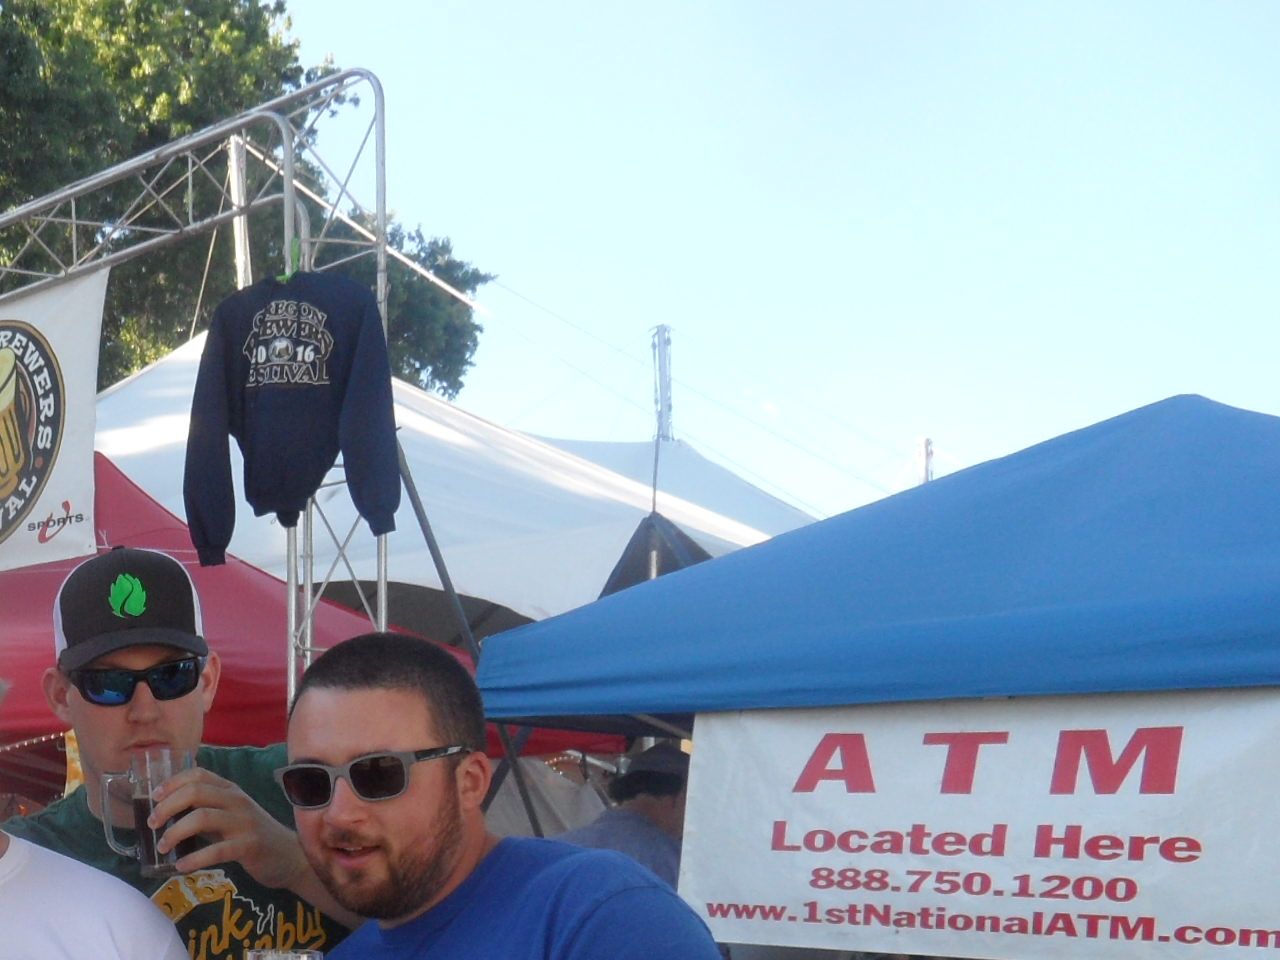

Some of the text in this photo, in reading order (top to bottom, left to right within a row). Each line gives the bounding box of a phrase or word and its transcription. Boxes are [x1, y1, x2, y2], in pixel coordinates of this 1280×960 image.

[245, 355, 331, 387] ESTIVAL
[295, 344, 316, 364] 16
[771, 820, 1202, 863] Located Here
[808, 867, 1138, 903] 888.750.1200
[706, 901, 1280, 949] www.1stNationalATM.com
